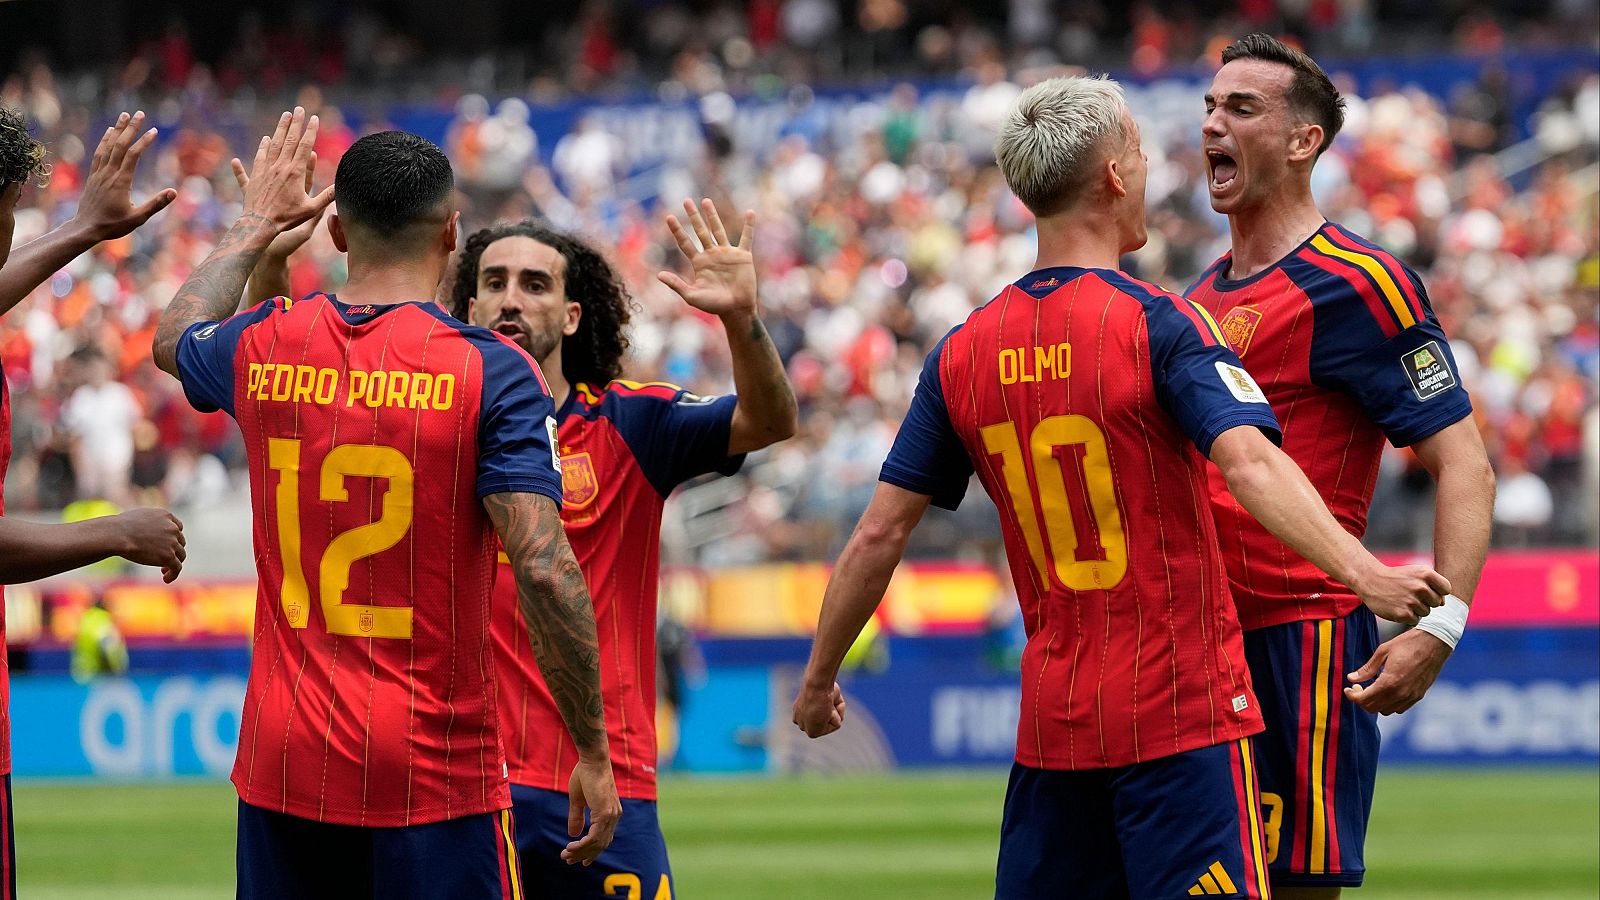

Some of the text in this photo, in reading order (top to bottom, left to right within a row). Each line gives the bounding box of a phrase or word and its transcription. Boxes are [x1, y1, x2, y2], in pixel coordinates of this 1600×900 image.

[247, 362, 455, 411] PEDRO PORRO
[999, 342, 1072, 385] OLMO
[1418, 370, 1449, 390] EDUCATION
[980, 414, 1128, 591] 10
[268, 437, 413, 639] 12
